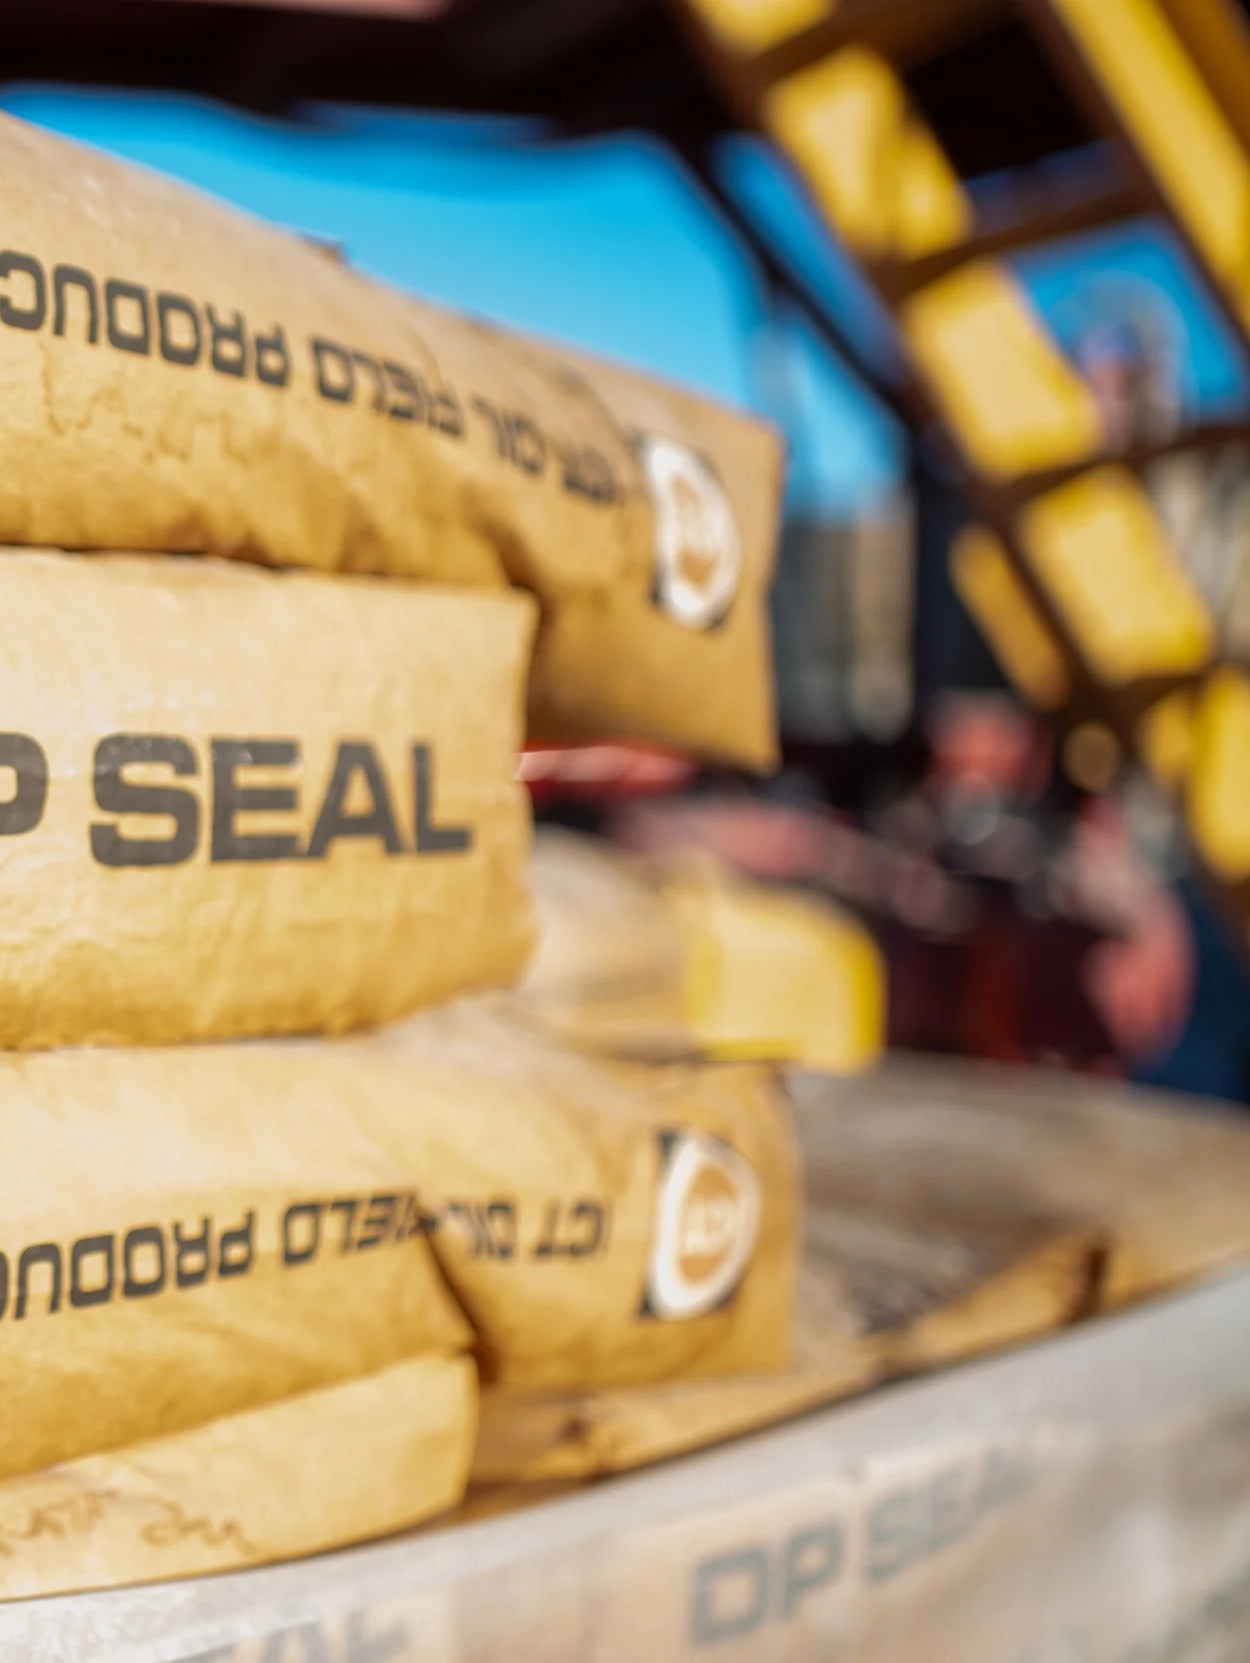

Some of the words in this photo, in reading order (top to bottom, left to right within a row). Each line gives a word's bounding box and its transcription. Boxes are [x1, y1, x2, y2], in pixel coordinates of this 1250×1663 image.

[310, 338, 465, 438] FIELD
[90, 731, 474, 868] SEAL
[690, 1519, 843, 1650] DP
